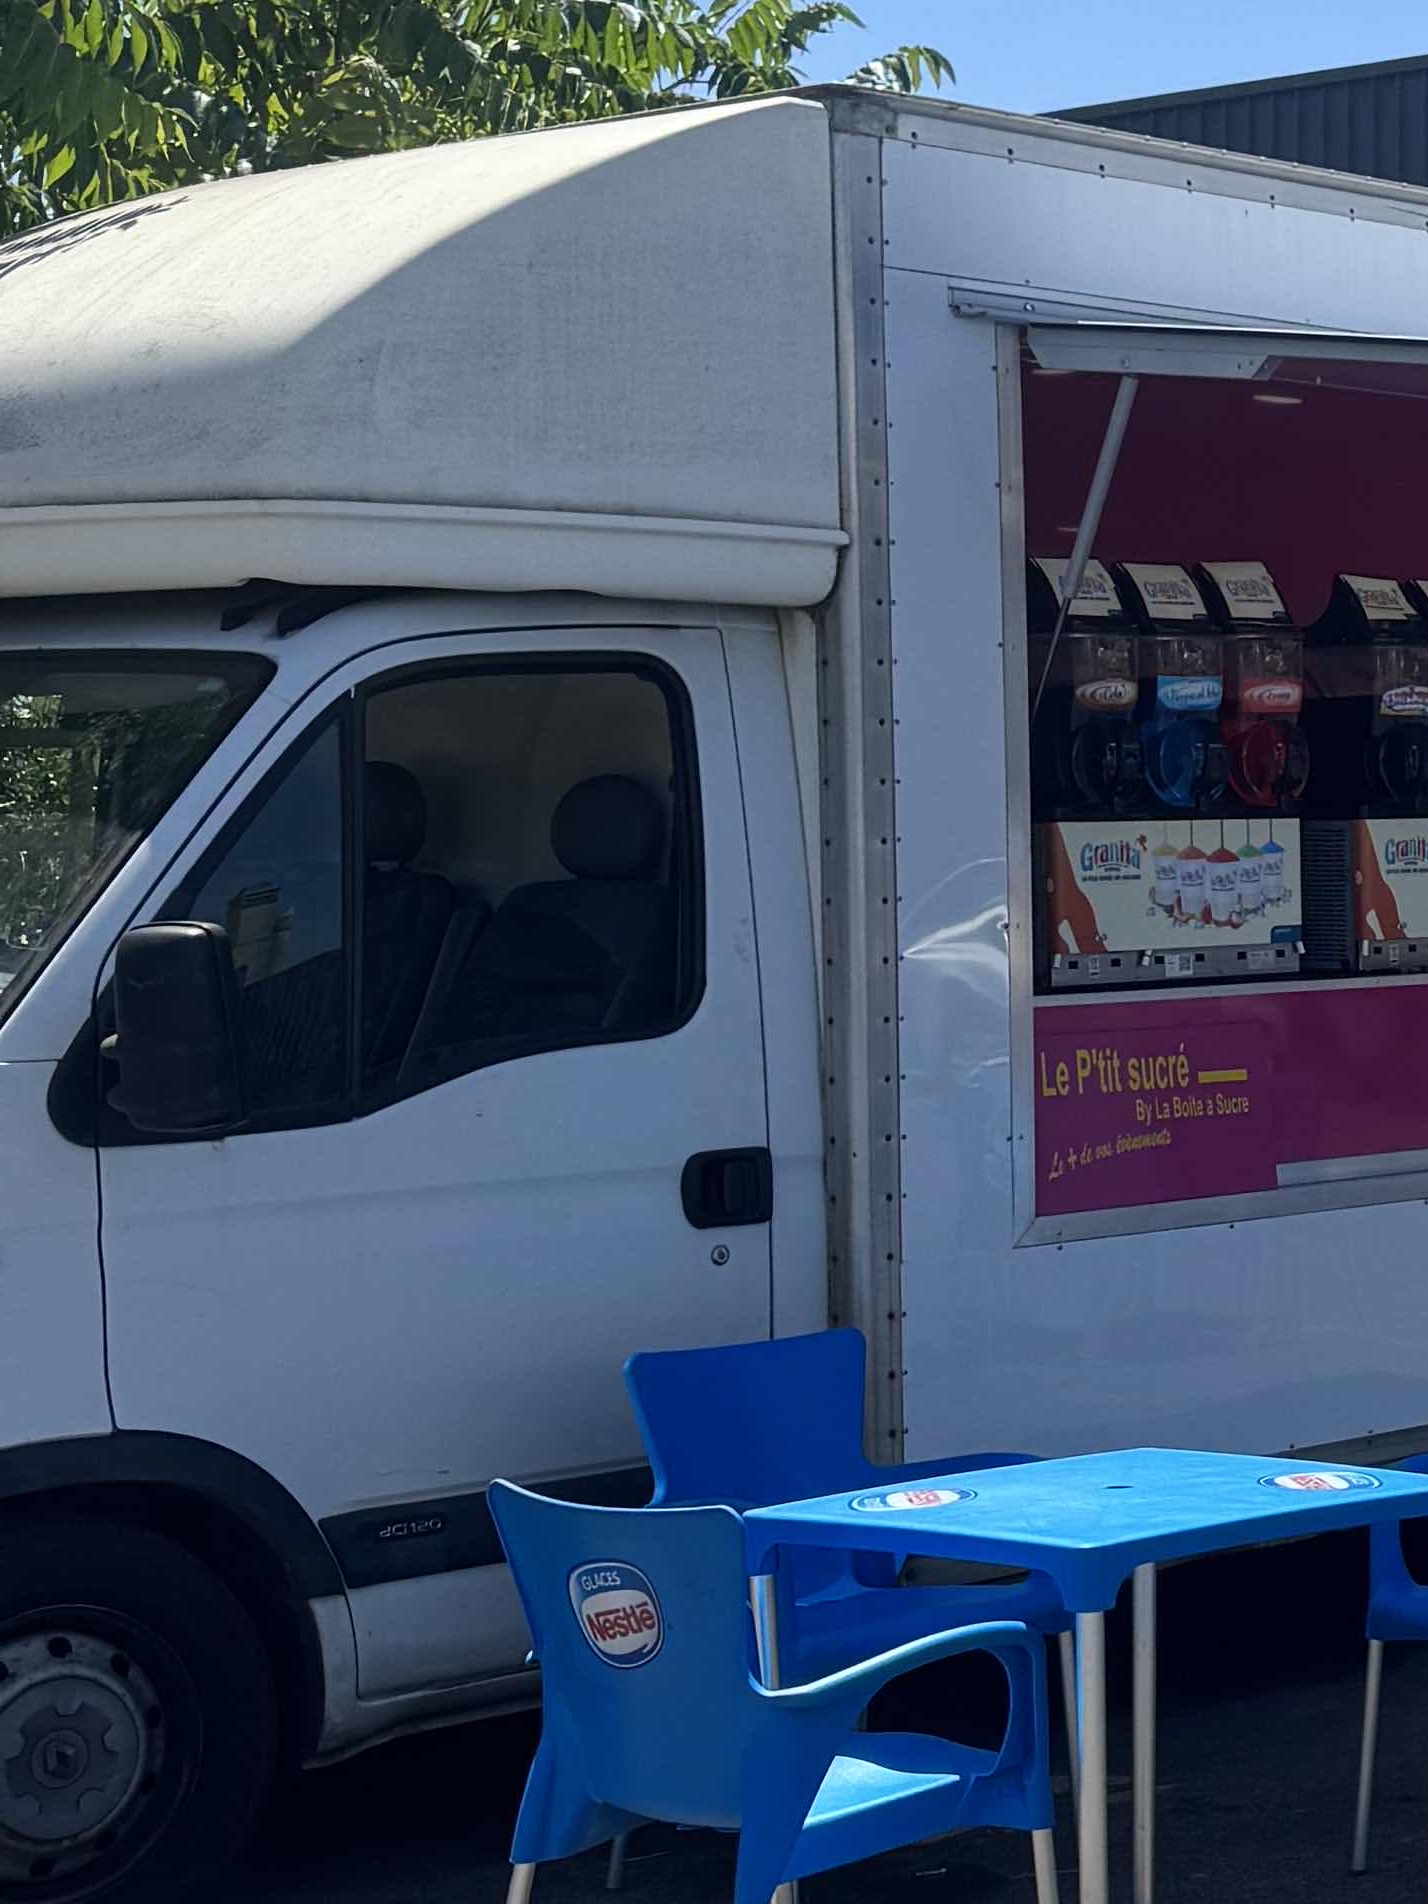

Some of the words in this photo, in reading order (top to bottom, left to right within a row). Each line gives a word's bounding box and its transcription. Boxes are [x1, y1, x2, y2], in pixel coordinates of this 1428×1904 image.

[1080, 840, 1141, 872] Granita
[1040, 1051, 1069, 1097] Le
[1075, 1048, 1123, 1095] P'tit
[1127, 1042, 1189, 1091] sucré
[1136, 1098, 1152, 1126] By
[1154, 1099, 1170, 1120] La
[1215, 1093, 1248, 1115] Sucre
[580, 1571, 621, 1591] GLACES
[586, 1601, 656, 1642] Nestlé
